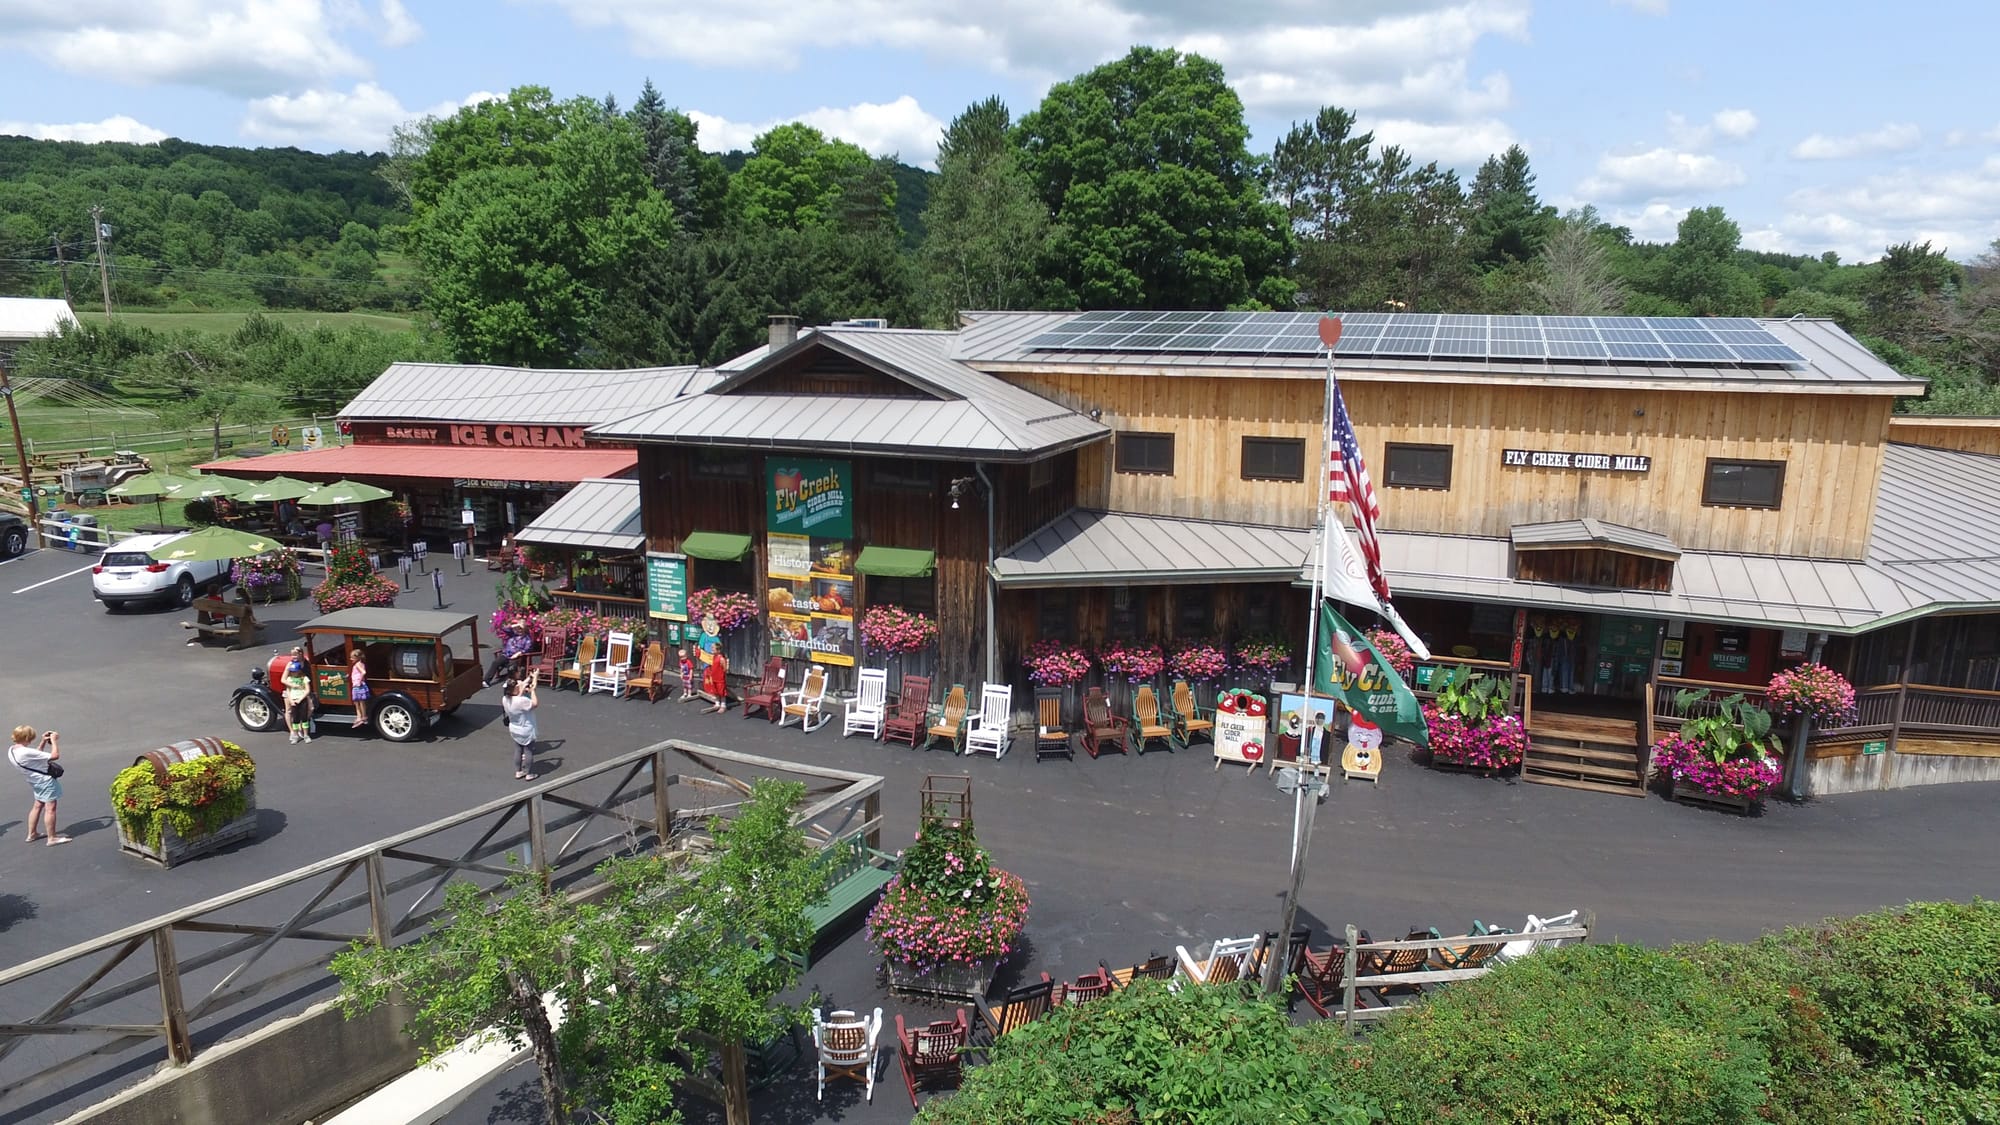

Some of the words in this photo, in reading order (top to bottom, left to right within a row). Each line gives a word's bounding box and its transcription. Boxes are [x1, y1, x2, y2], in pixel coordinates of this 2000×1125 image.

[386, 427, 438, 440] BAKERY
[450, 425, 489, 446] ICE
[495, 425, 586, 448] CREAM
[1505, 450, 1529, 465] FLY
[1532, 452, 1571, 467] CREEK
[1574, 454, 1611, 469] CIDER
[1614, 456, 1648, 471] MILL
[467, 478, 479, 486] Ice
[775, 487, 797, 512] Fly
[799, 467, 840, 501] Creek
[807, 493, 826, 508] CIDER
[827, 490, 844, 500] MILL
[774, 555, 813, 571] History
[1330, 654, 1357, 691] Fly
[1367, 694, 1396, 705] CIDE
[1224, 729, 1240, 737] CIDER
[1230, 723, 1245, 731] CREEK
